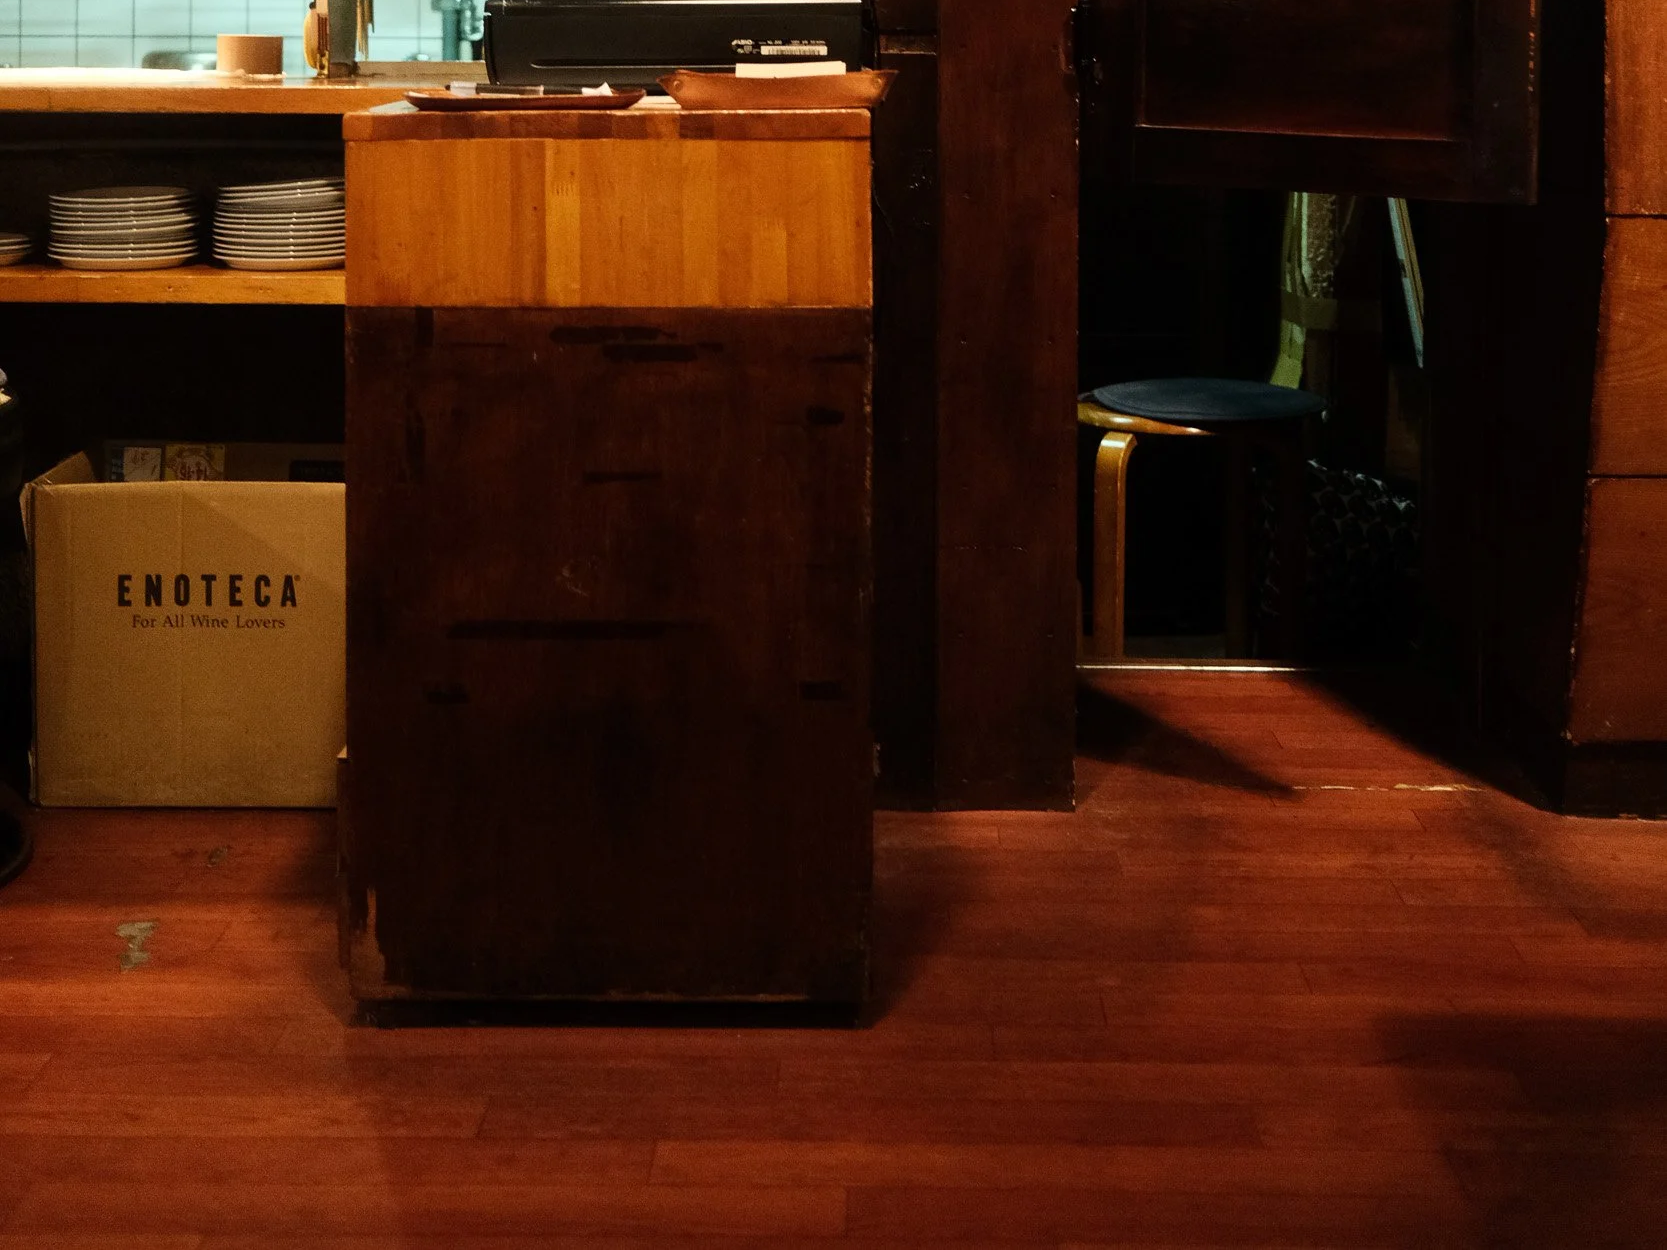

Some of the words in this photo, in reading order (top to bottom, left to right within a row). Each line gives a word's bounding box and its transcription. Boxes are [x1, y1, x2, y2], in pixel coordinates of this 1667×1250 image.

[117, 573, 297, 607] ENOTECA
[132, 614, 157, 629] For
[162, 614, 185, 629] All
[190, 614, 229, 629] Wine
[236, 614, 286, 629] Lovers
